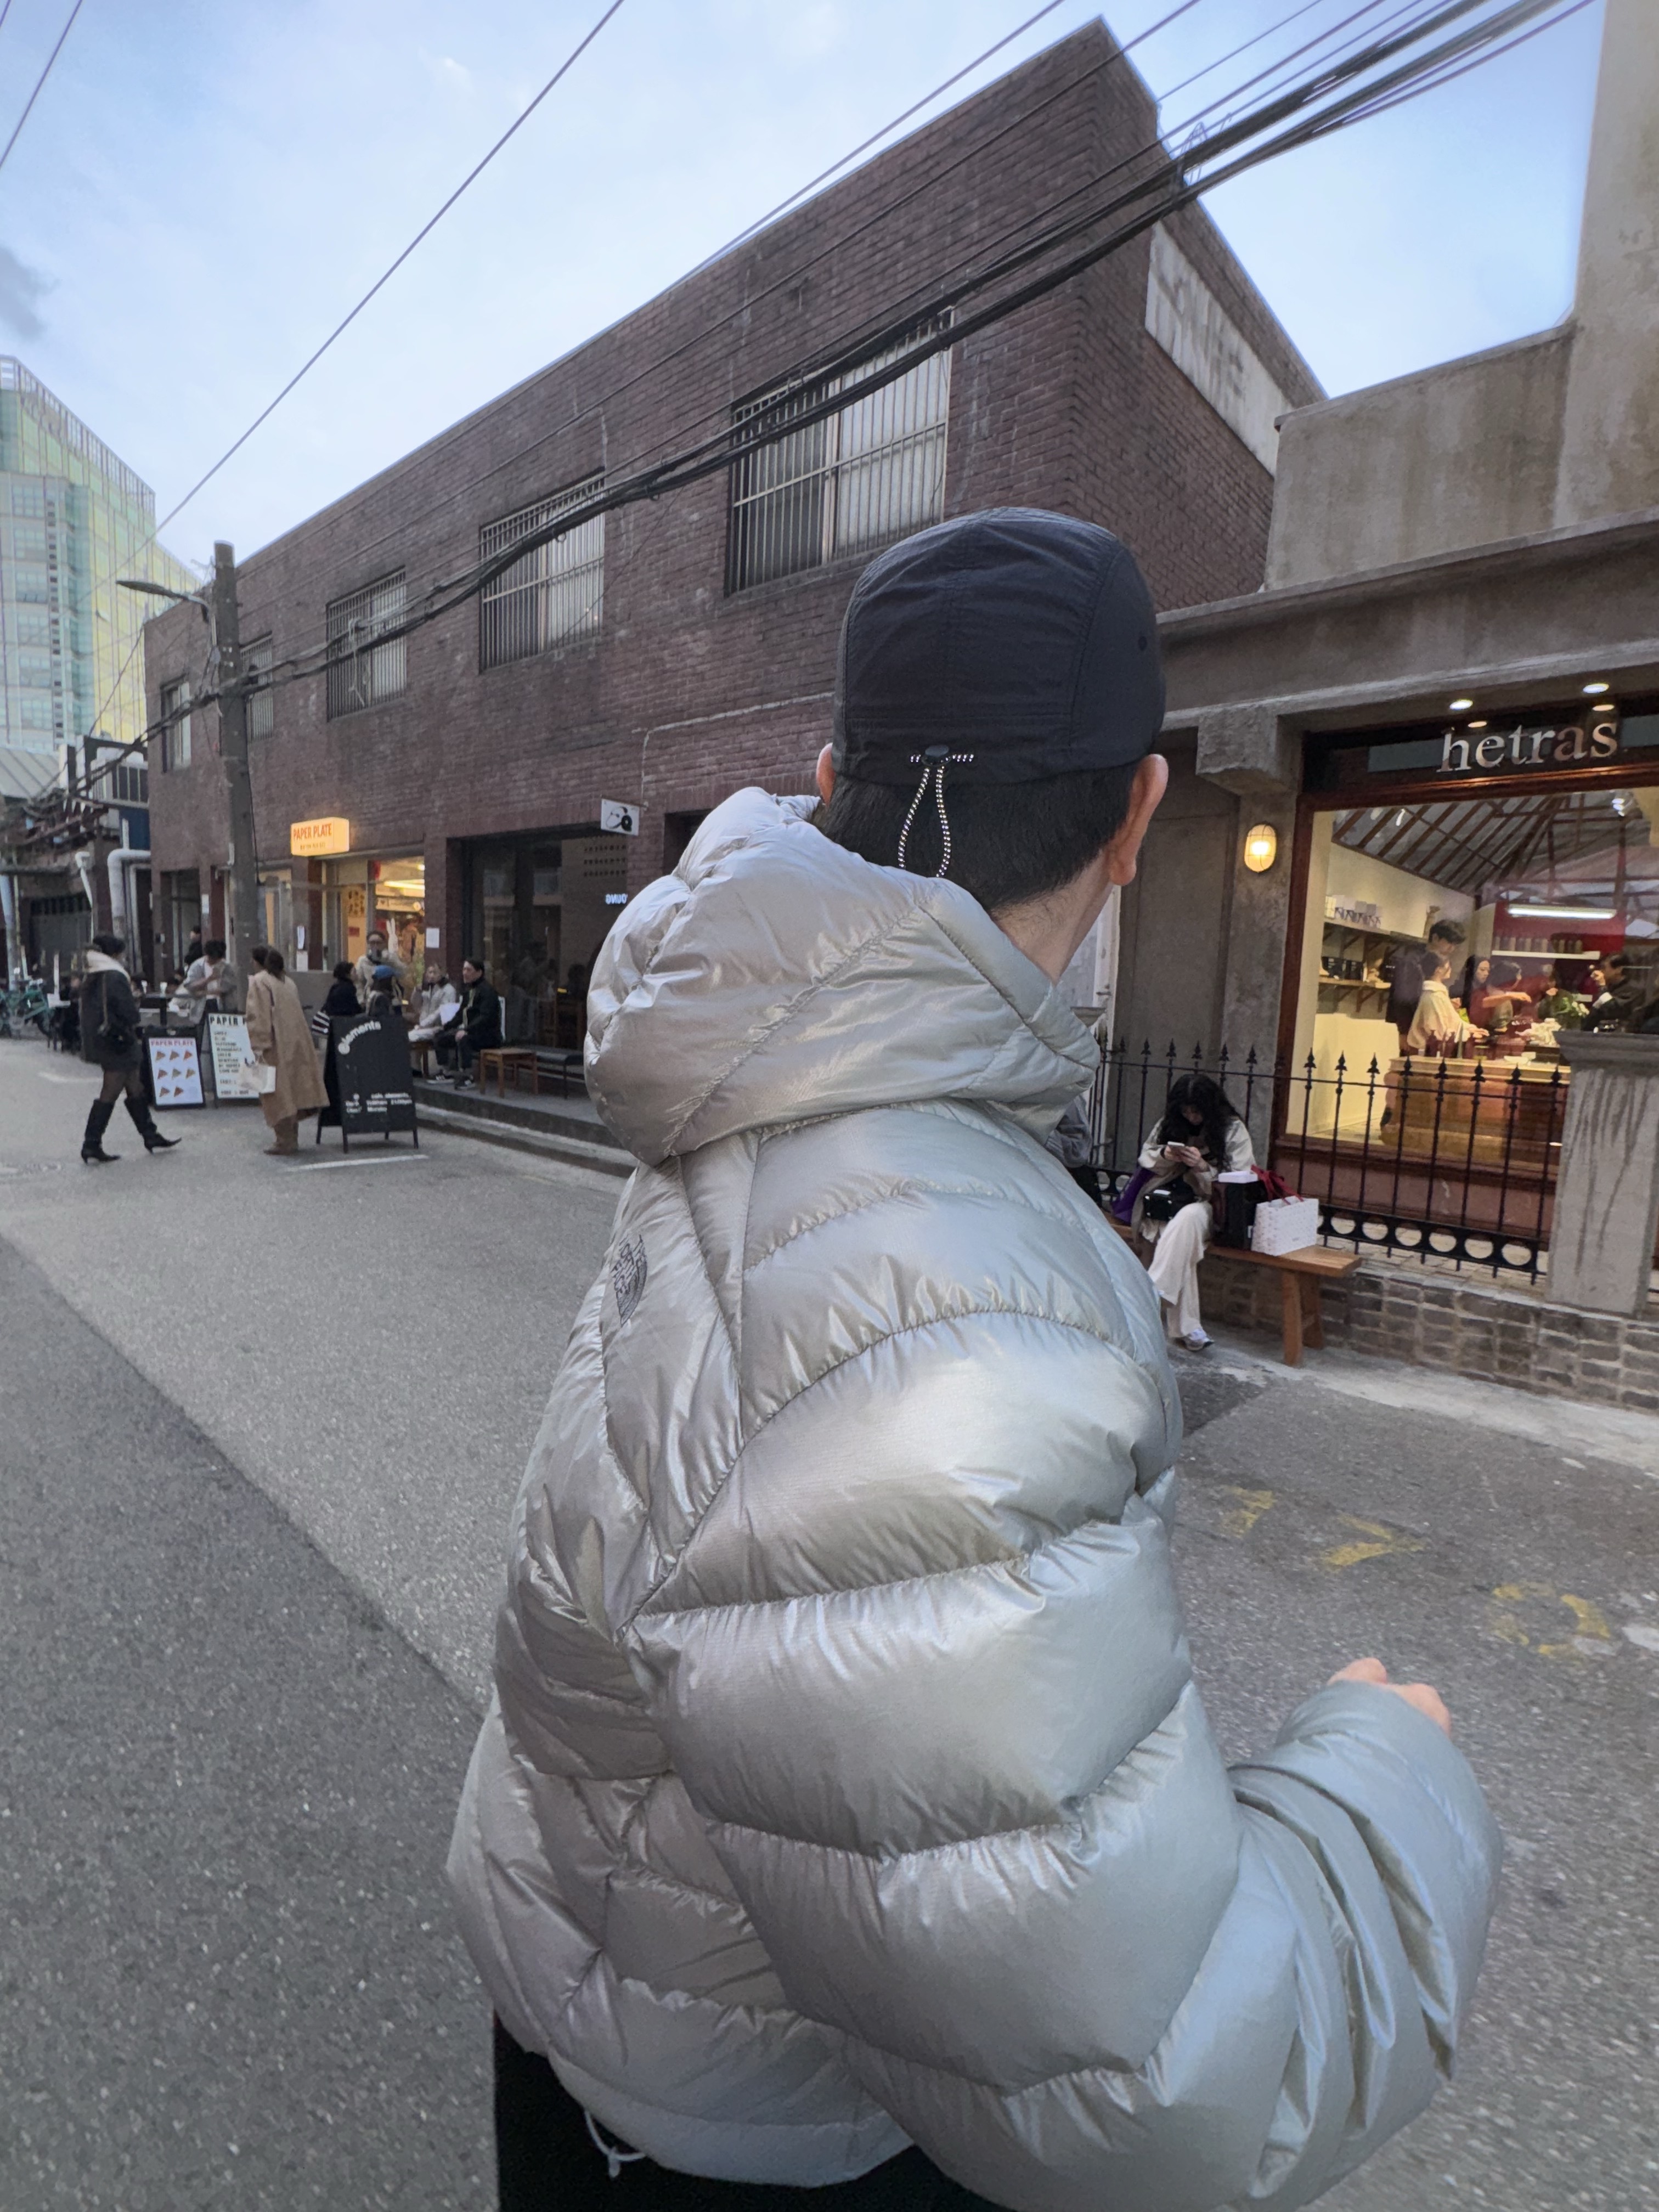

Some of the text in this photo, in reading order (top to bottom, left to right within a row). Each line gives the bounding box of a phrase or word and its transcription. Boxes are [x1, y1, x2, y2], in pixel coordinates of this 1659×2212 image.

[1436, 722, 1618, 773] hetras
[294, 823, 331, 840] PAPER PLATE
[210, 1015, 238, 1026] PAPER
[633, 1234, 647, 1265] THE
[610, 1260, 627, 1300] FACE
